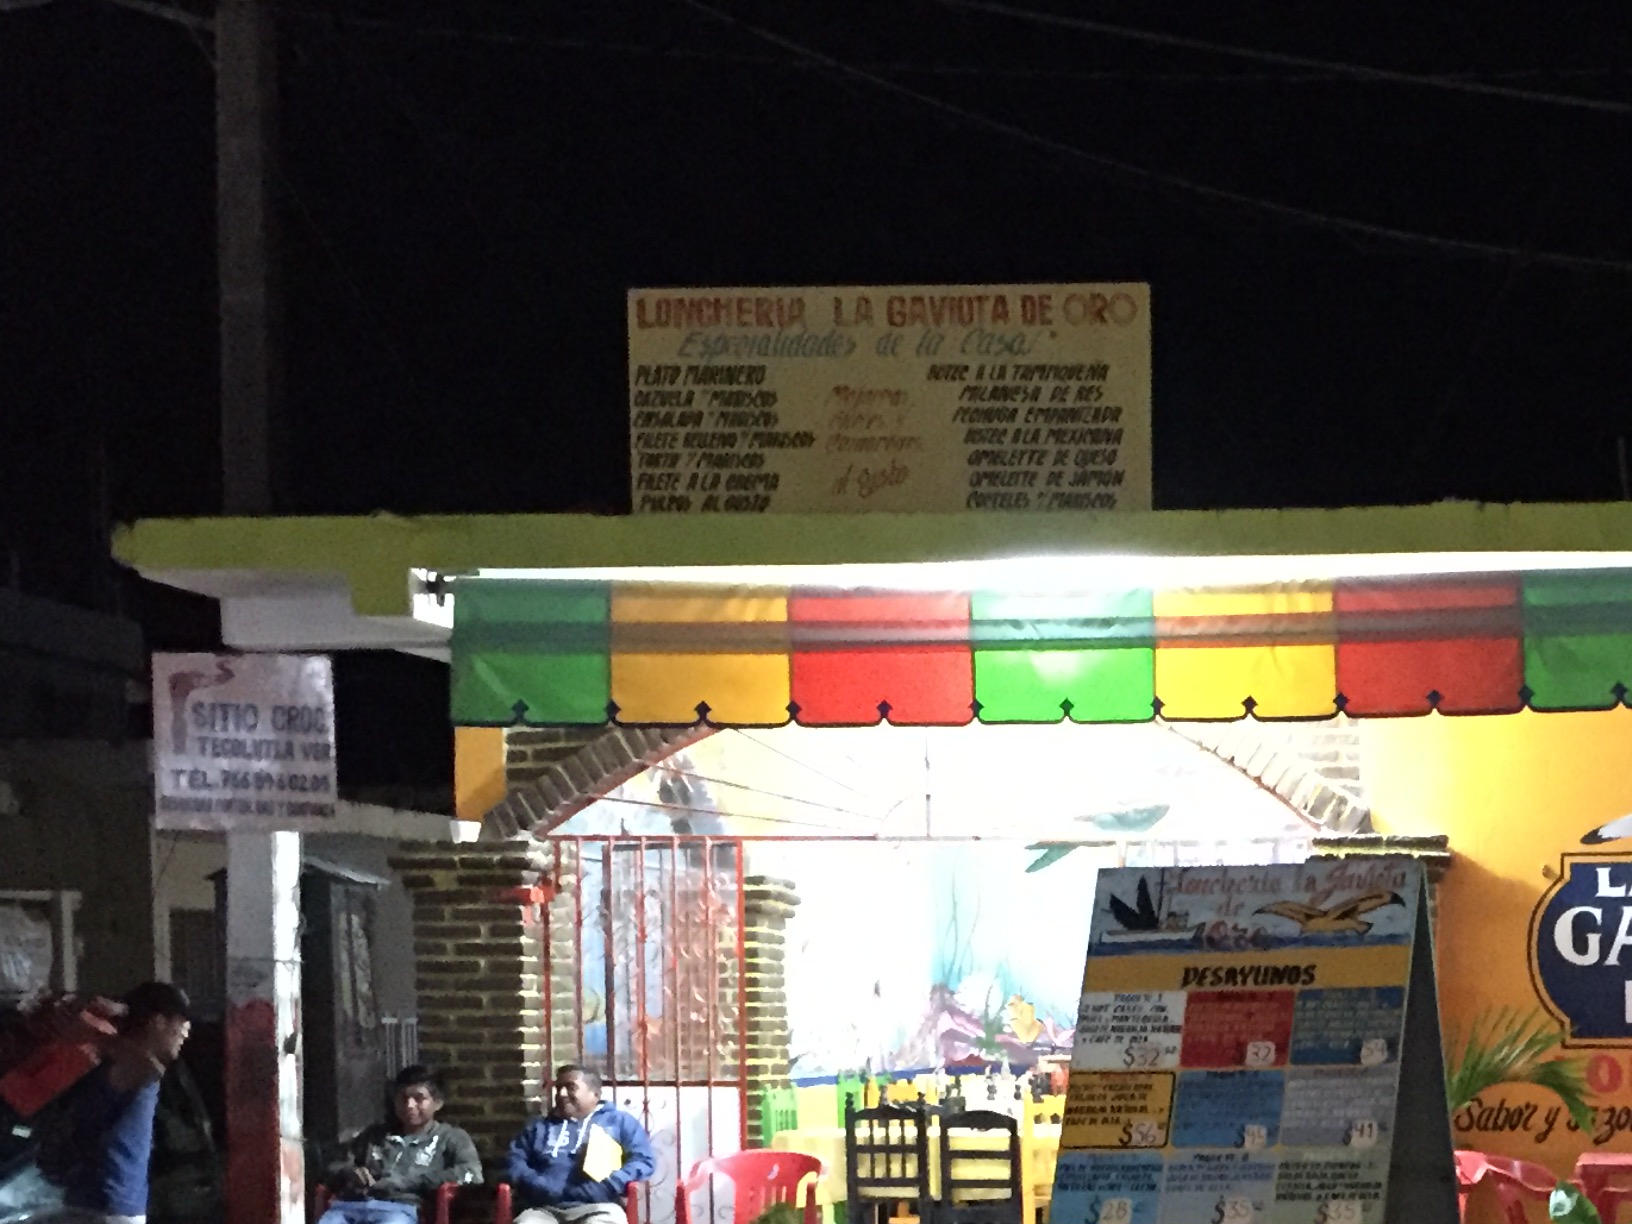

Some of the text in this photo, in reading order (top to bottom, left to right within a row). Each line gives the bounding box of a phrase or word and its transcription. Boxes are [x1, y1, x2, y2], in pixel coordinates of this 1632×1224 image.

[636, 292, 1138, 329] LONCHERIA LA GAVIOTA DE ORO
[958, 384, 1042, 402] MILANESA
[1048, 385, 1072, 402] DE
[191, 702, 259, 732] SITIO
[1181, 964, 1317, 989] DESAYUNOS
[1454, 1097, 1540, 1133] Sabor
[1534, 1105, 1563, 1144] y
